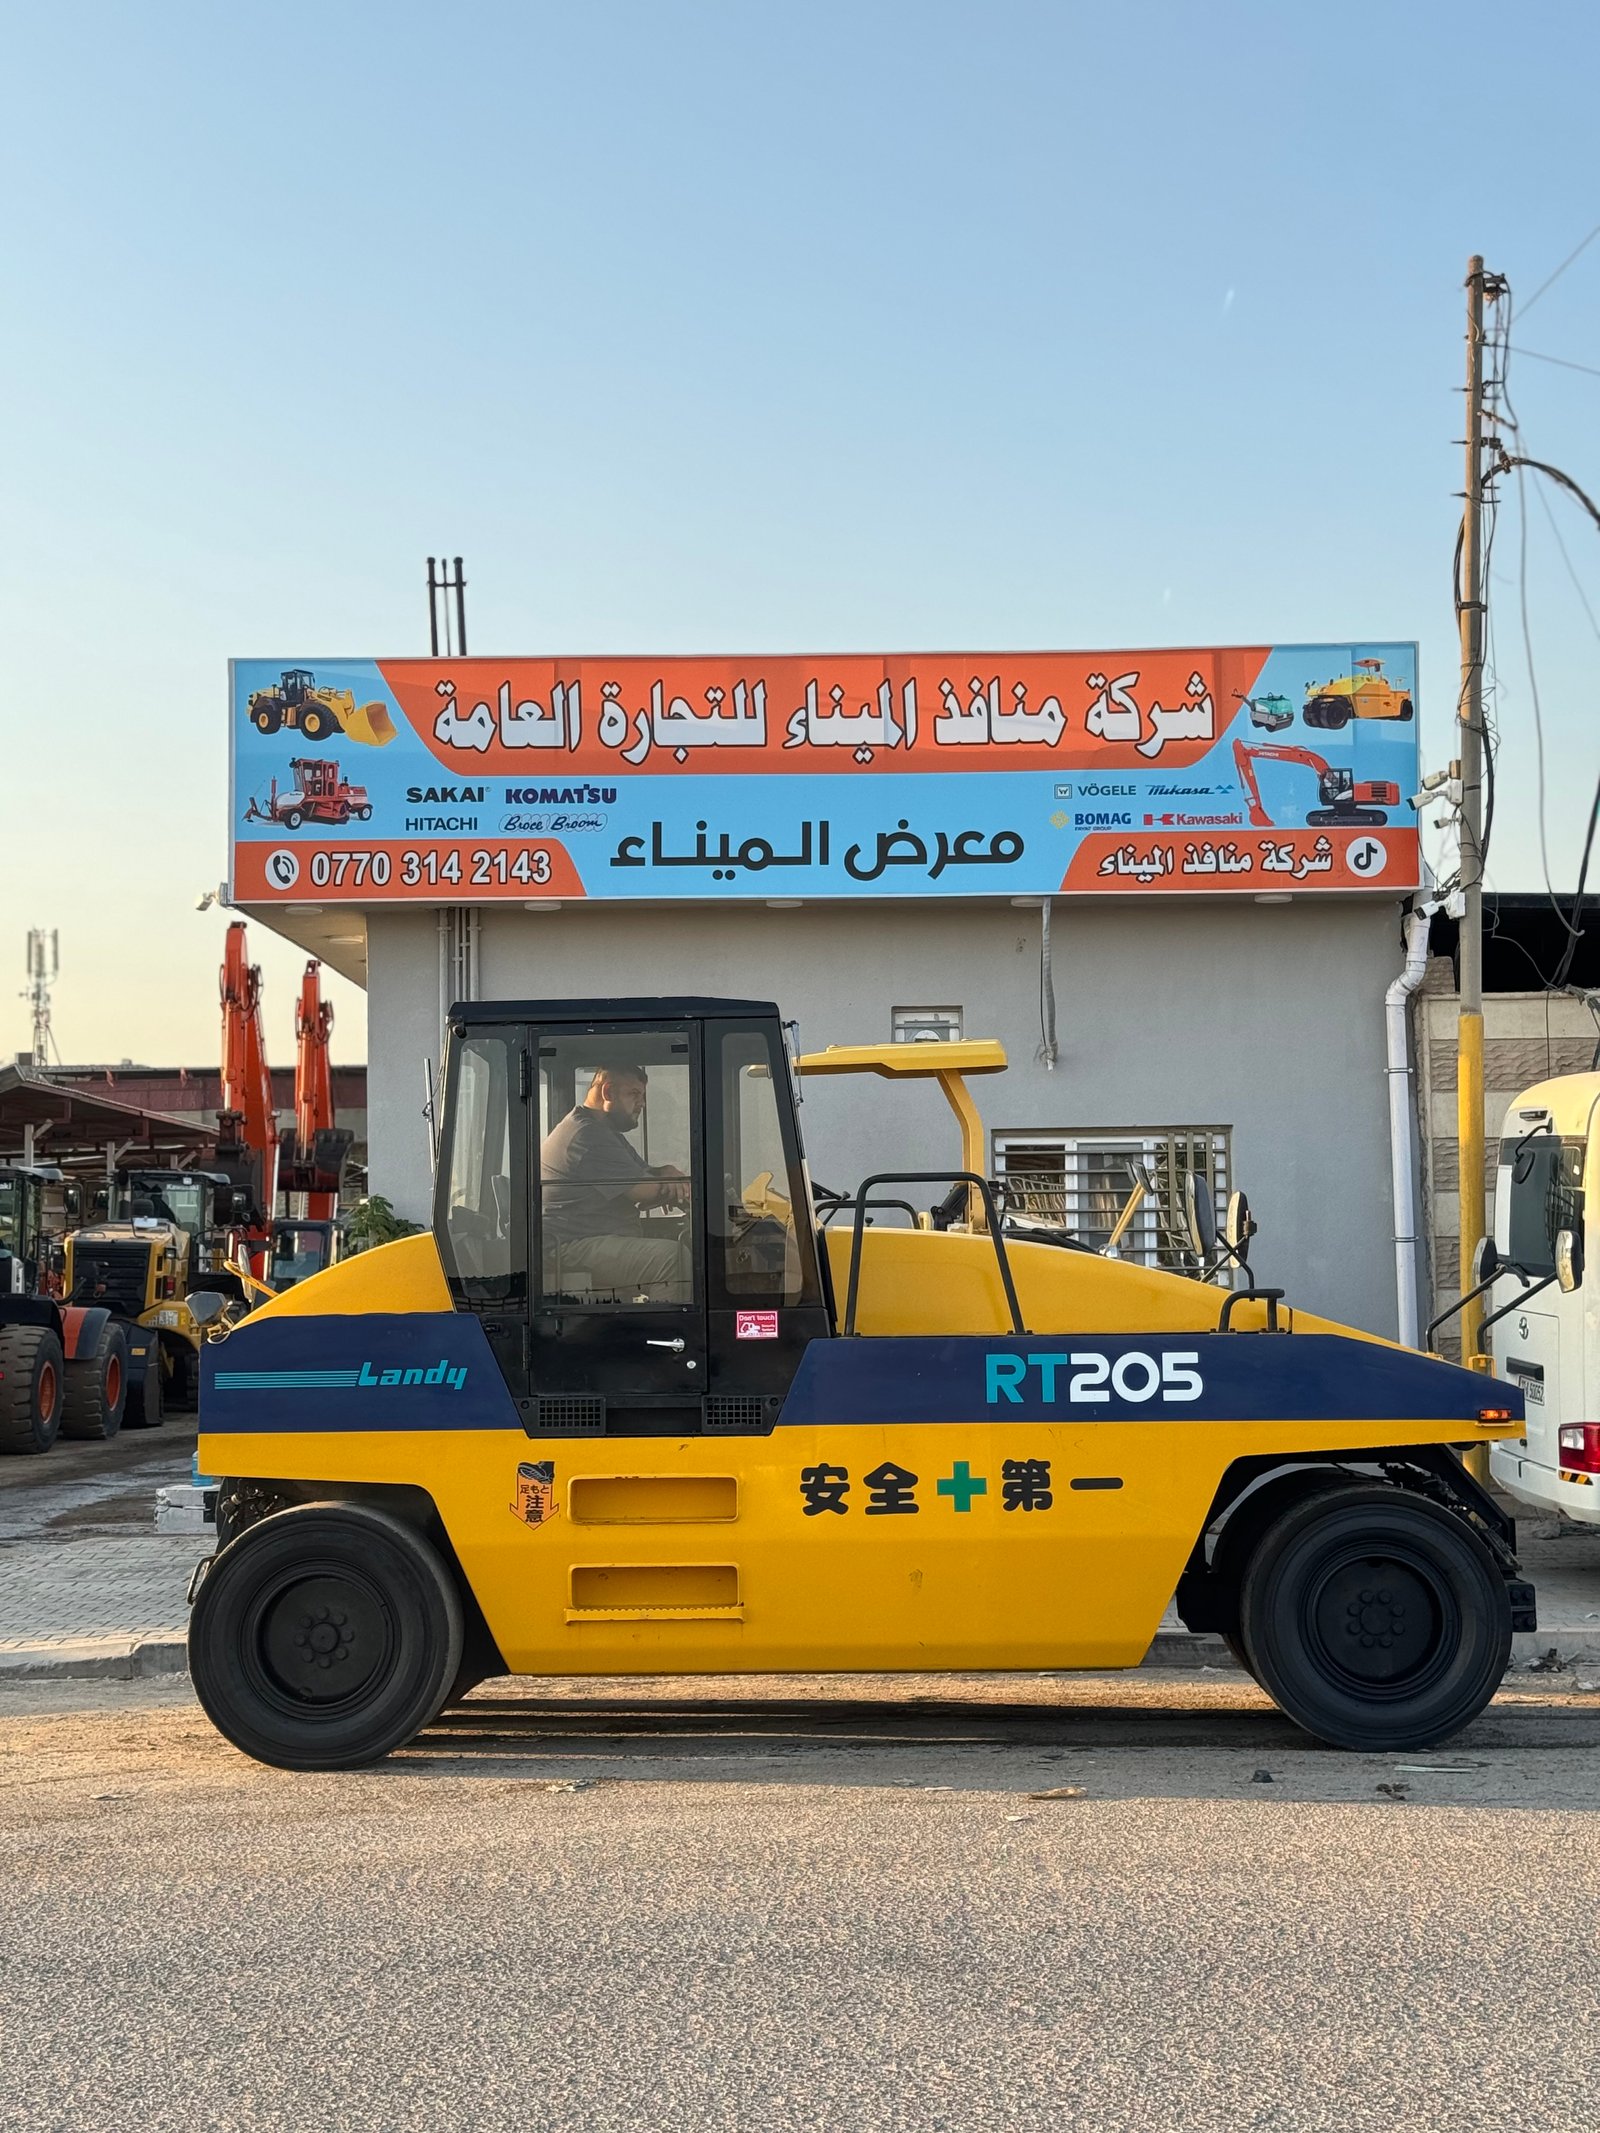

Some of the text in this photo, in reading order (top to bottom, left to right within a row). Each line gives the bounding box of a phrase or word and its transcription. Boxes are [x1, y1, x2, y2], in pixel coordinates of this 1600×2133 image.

[434, 671, 1214, 765] شركة منافذ الميناء للتجارة العامة
[406, 787, 484, 803] SAKAI
[505, 784, 617, 804] KOMATSU
[1077, 783, 1137, 796] VÖGELE
[1145, 784, 1215, 795] Mikasa
[405, 817, 478, 831] HITACHI
[504, 815, 602, 831] Broce Broom
[1075, 813, 1131, 825] BOMAG
[1176, 812, 1243, 825] Kawasaki
[610, 819, 1024, 881] معرض الميناء
[1097, 835, 1332, 884] شركة منافذ الميناء
[311, 849, 551, 886] 0770 314 2143
[358, 1360, 468, 1390] Landy
[985, 1351, 1204, 1404] RT205
[520, 1485, 549, 1494] 足もと
[799, 1458, 1124, 1516] 安全 第一
[525, 1495, 544, 1522] 注意
